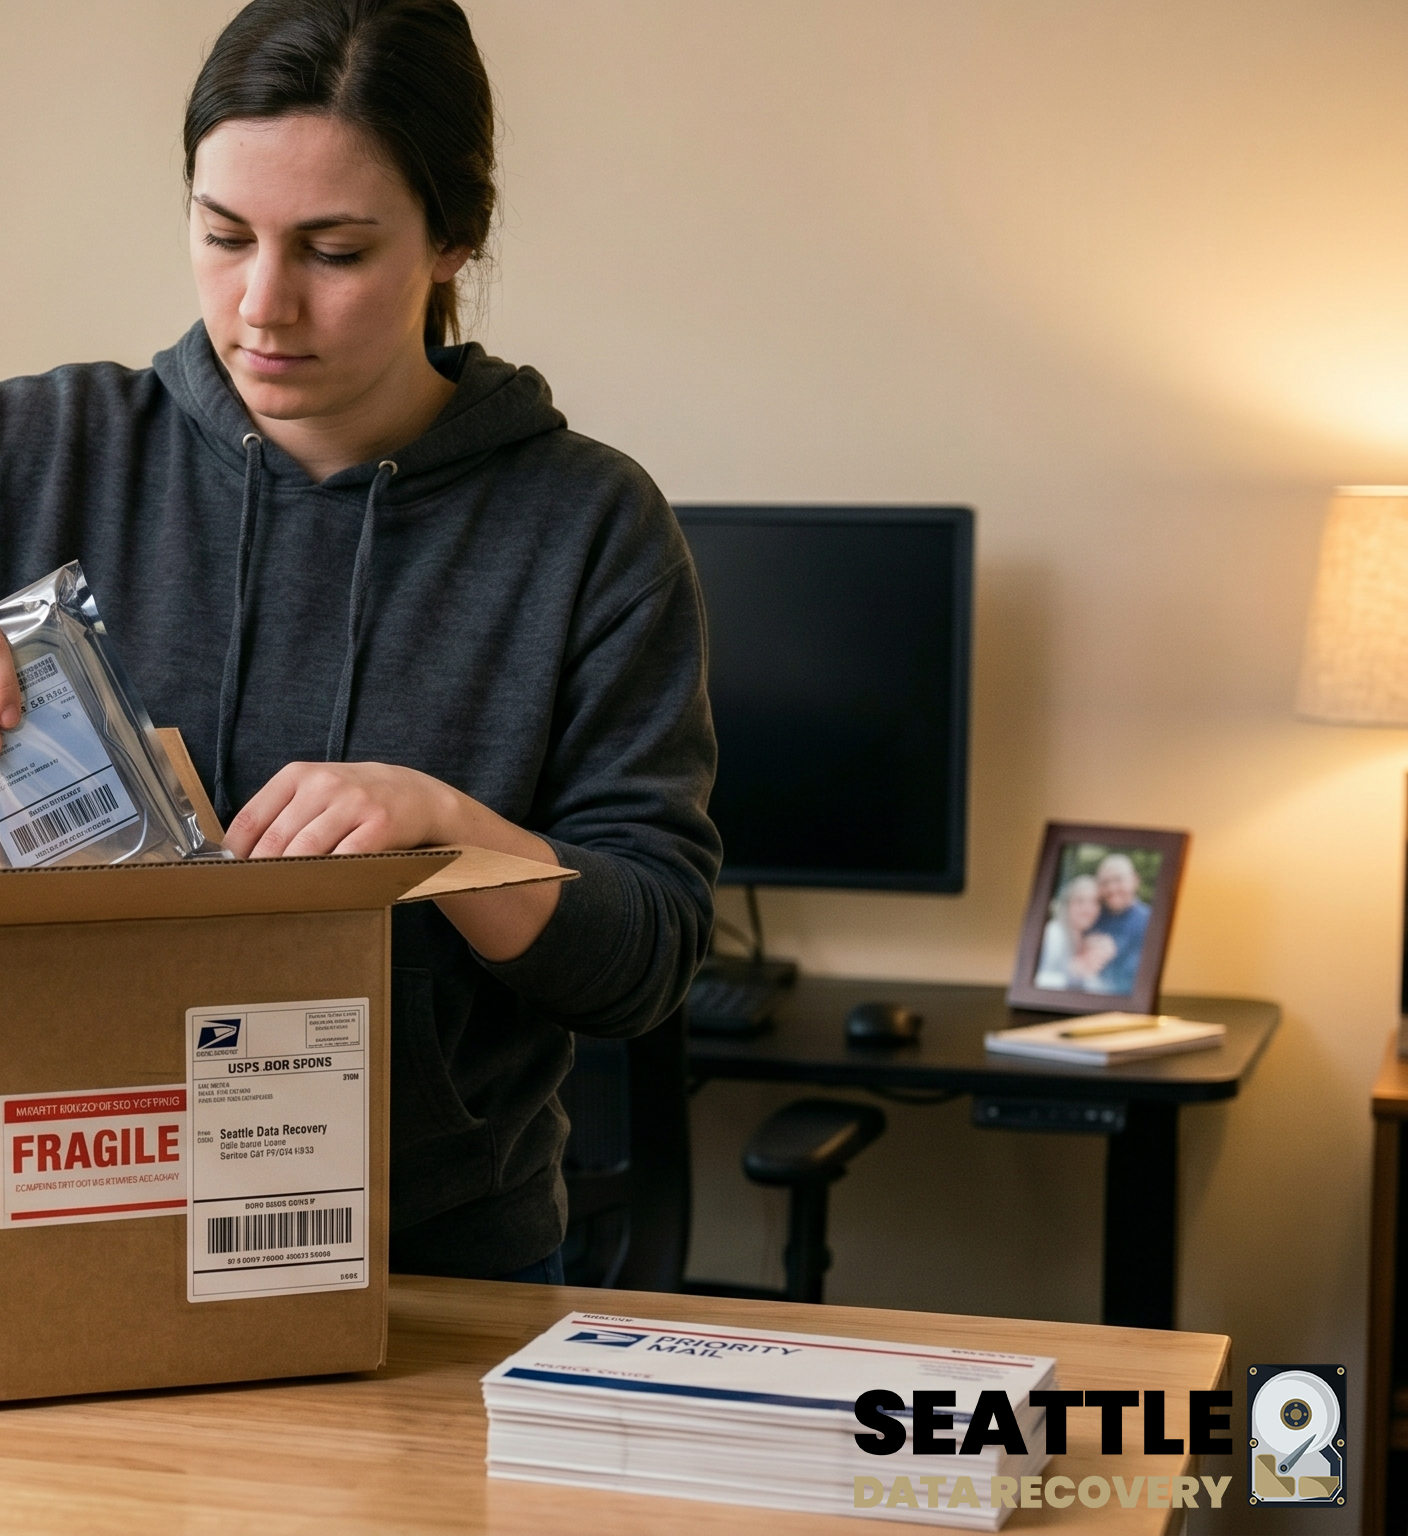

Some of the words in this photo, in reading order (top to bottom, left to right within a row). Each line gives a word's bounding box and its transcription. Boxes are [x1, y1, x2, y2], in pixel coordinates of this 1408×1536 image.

[228, 1060, 260, 1074] USPS
[293, 1057, 332, 1070] SPONS
[220, 1127, 254, 1140] Seattle
[257, 1125, 280, 1137] Data
[282, 1123, 327, 1136] Recovery
[13, 1124, 180, 1174] FRAGILE
[647, 1344, 723, 1359] MAIL
[655, 1335, 802, 1355] PRIORITY
